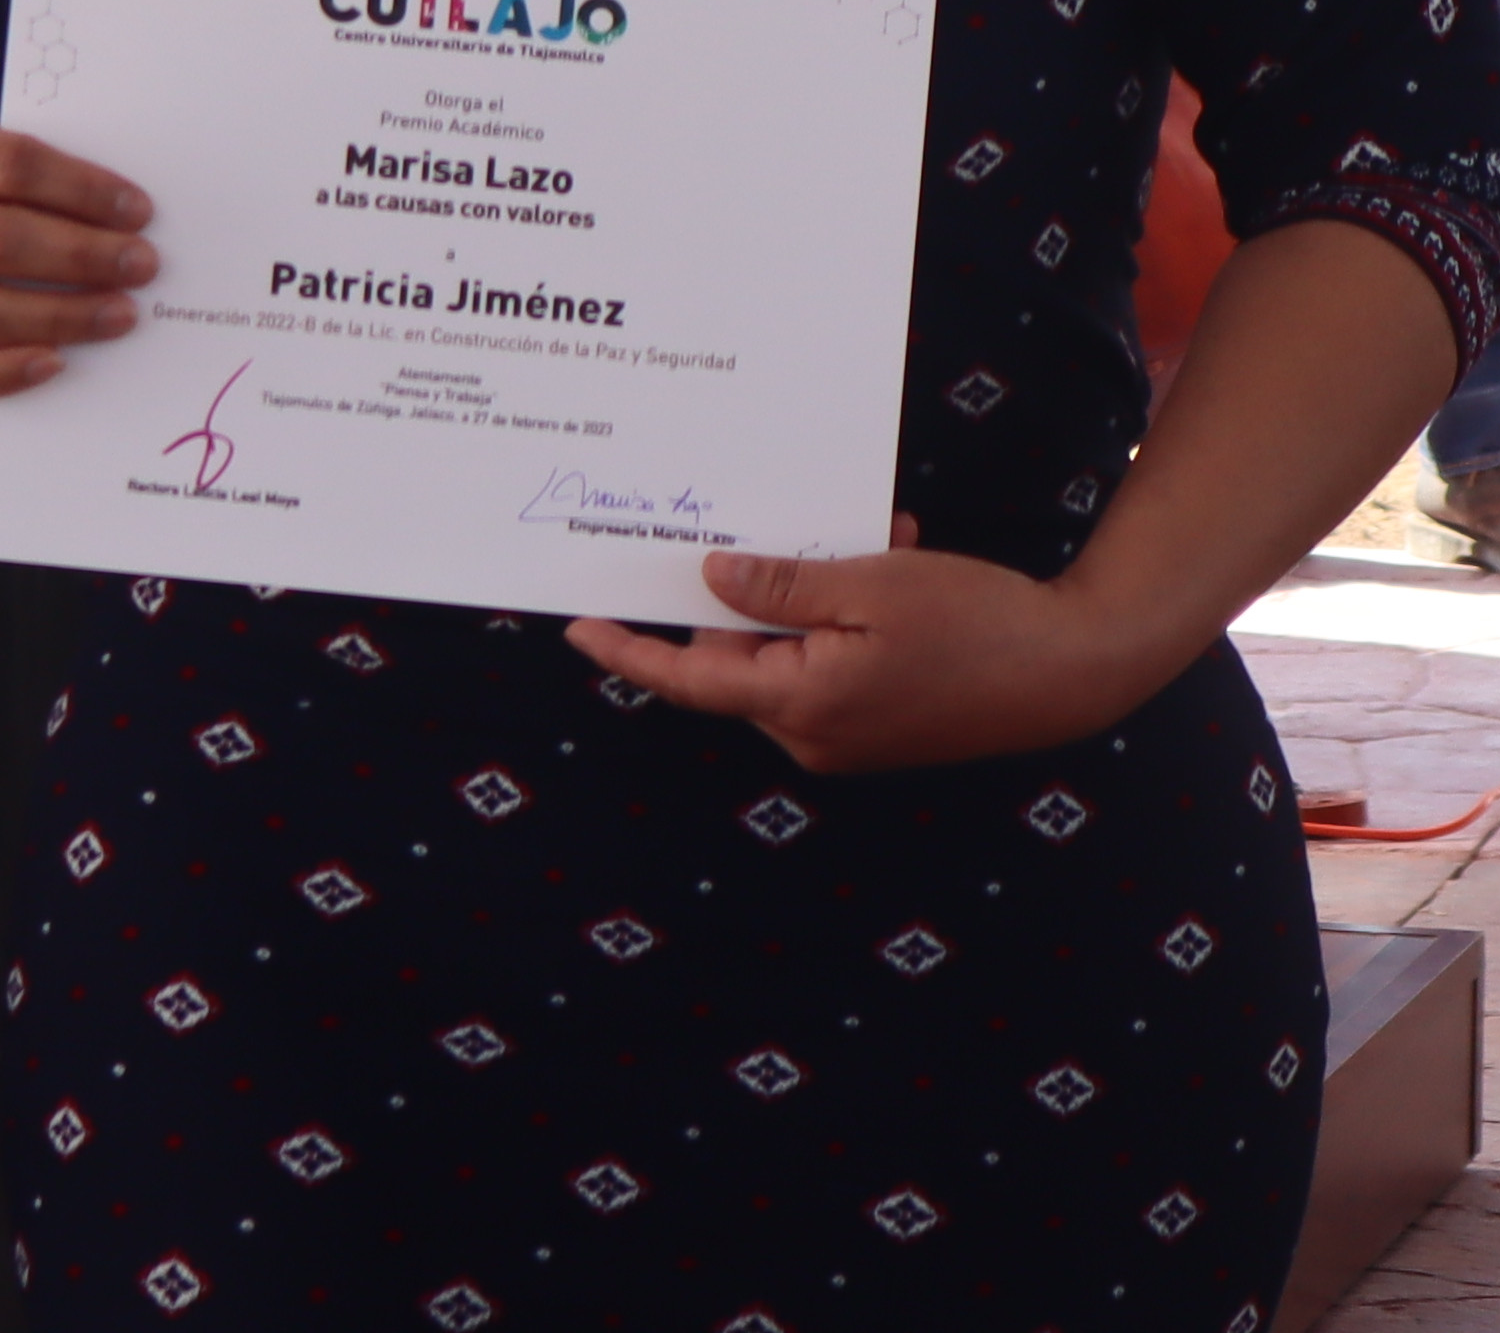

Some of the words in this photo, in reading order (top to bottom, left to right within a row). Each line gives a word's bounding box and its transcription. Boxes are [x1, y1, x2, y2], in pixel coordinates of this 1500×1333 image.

[334, 28, 386, 44] Centro
[390, 34, 491, 54] Universitario
[496, 43, 514, 56] de
[520, 44, 605, 64] Tlajomulco
[425, 90, 483, 114] Otorga
[489, 96, 504, 112] el
[380, 111, 444, 132] Premio
[448, 116, 544, 142] Académico
[344, 143, 475, 186] Marisa
[485, 156, 574, 195] Lazo
[316, 190, 330, 206] a
[335, 186, 369, 208] las
[375, 194, 455, 217] causas
[460, 202, 501, 220] con
[507, 204, 596, 229] valores
[446, 248, 455, 262] a
[270, 261, 435, 309] Patricia
[446, 278, 626, 327] Jiménez
[152, 302, 251, 326] Generación
[256, 311, 317, 332] 2022-B
[322, 319, 342, 334] de
[348, 321, 363, 338] la
[404, 329, 425, 343] en
[431, 327, 543, 354] Construcción
[549, 338, 569, 356] de
[575, 340, 590, 358] la
[595, 342, 626, 361] Paz
[632, 348, 642, 366] y
[647, 346, 737, 371] Seguridad
[398, 366, 482, 386] Atentamente
[262, 390, 333, 411] Tlajomulco
[337, 399, 353, 413] de
[492, 413, 506, 426] de
[512, 415, 560, 432] febrero
[564, 419, 578, 433] de
[703, 531, 736, 545] Lazo
